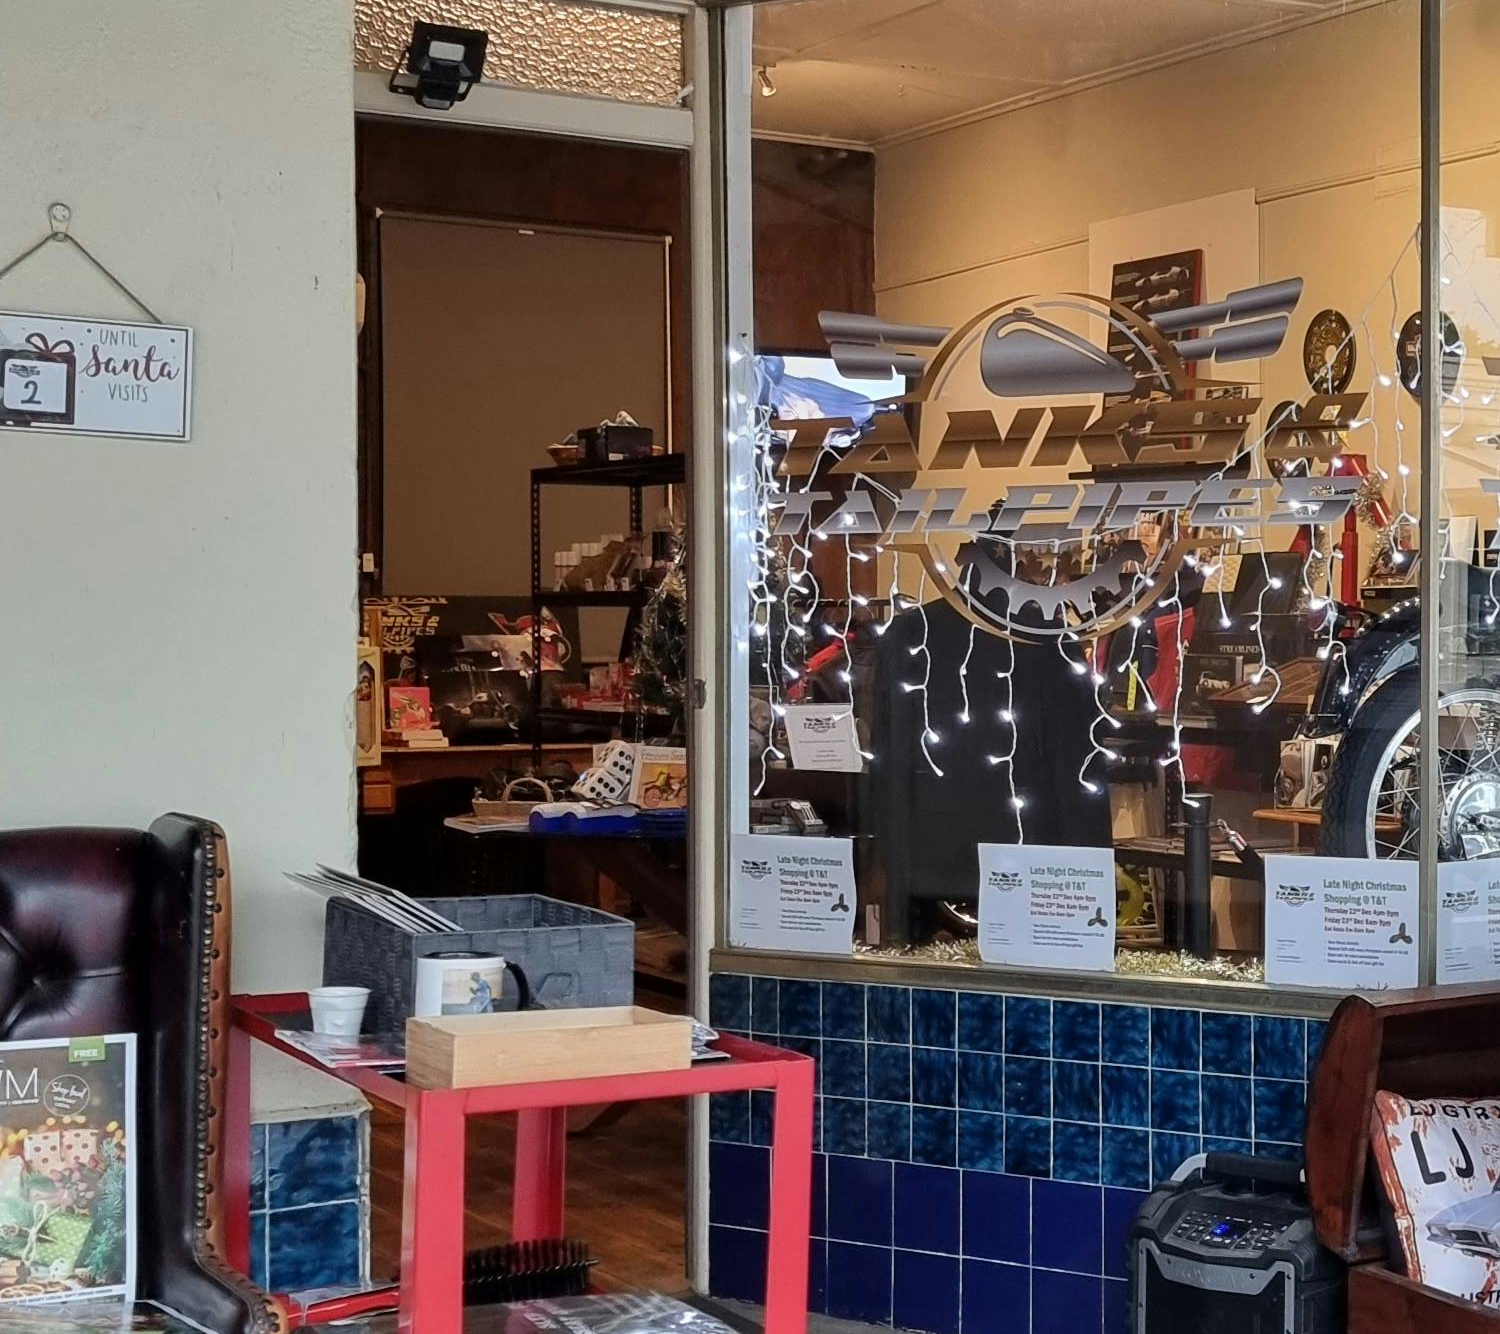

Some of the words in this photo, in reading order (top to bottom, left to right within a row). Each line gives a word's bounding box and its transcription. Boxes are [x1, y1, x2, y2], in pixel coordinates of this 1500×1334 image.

[100, 329, 138, 348] UNTIL
[78, 345, 180, 382] Santa
[20, 380, 42, 405] 2
[108, 382, 149, 403] VISITS
[770, 397, 1264, 473] TANKS
[1264, 392, 1369, 463] &
[770, 477, 1364, 535] TAILPIPES
[1030, 867, 1045, 876] Late
[1047, 868, 1066, 878] Night
[1068, 868, 1104, 878] Christmas
[1031, 880, 1063, 891] Shopping
[1323, 879, 1340, 889] Late
[1342, 880, 1364, 892] Night
[1366, 881, 1407, 891] Christmas
[1324, 894, 1361, 906] Shopping
[1363, 895, 1369, 905] @
[1371, 896, 1386, 905] T&T
[1324, 907, 1348, 915] Thursday
[73, 1048, 98, 1058] FREE
[1442, 1104, 1490, 1120] GTR
[1410, 1126, 1474, 1185] LJ
